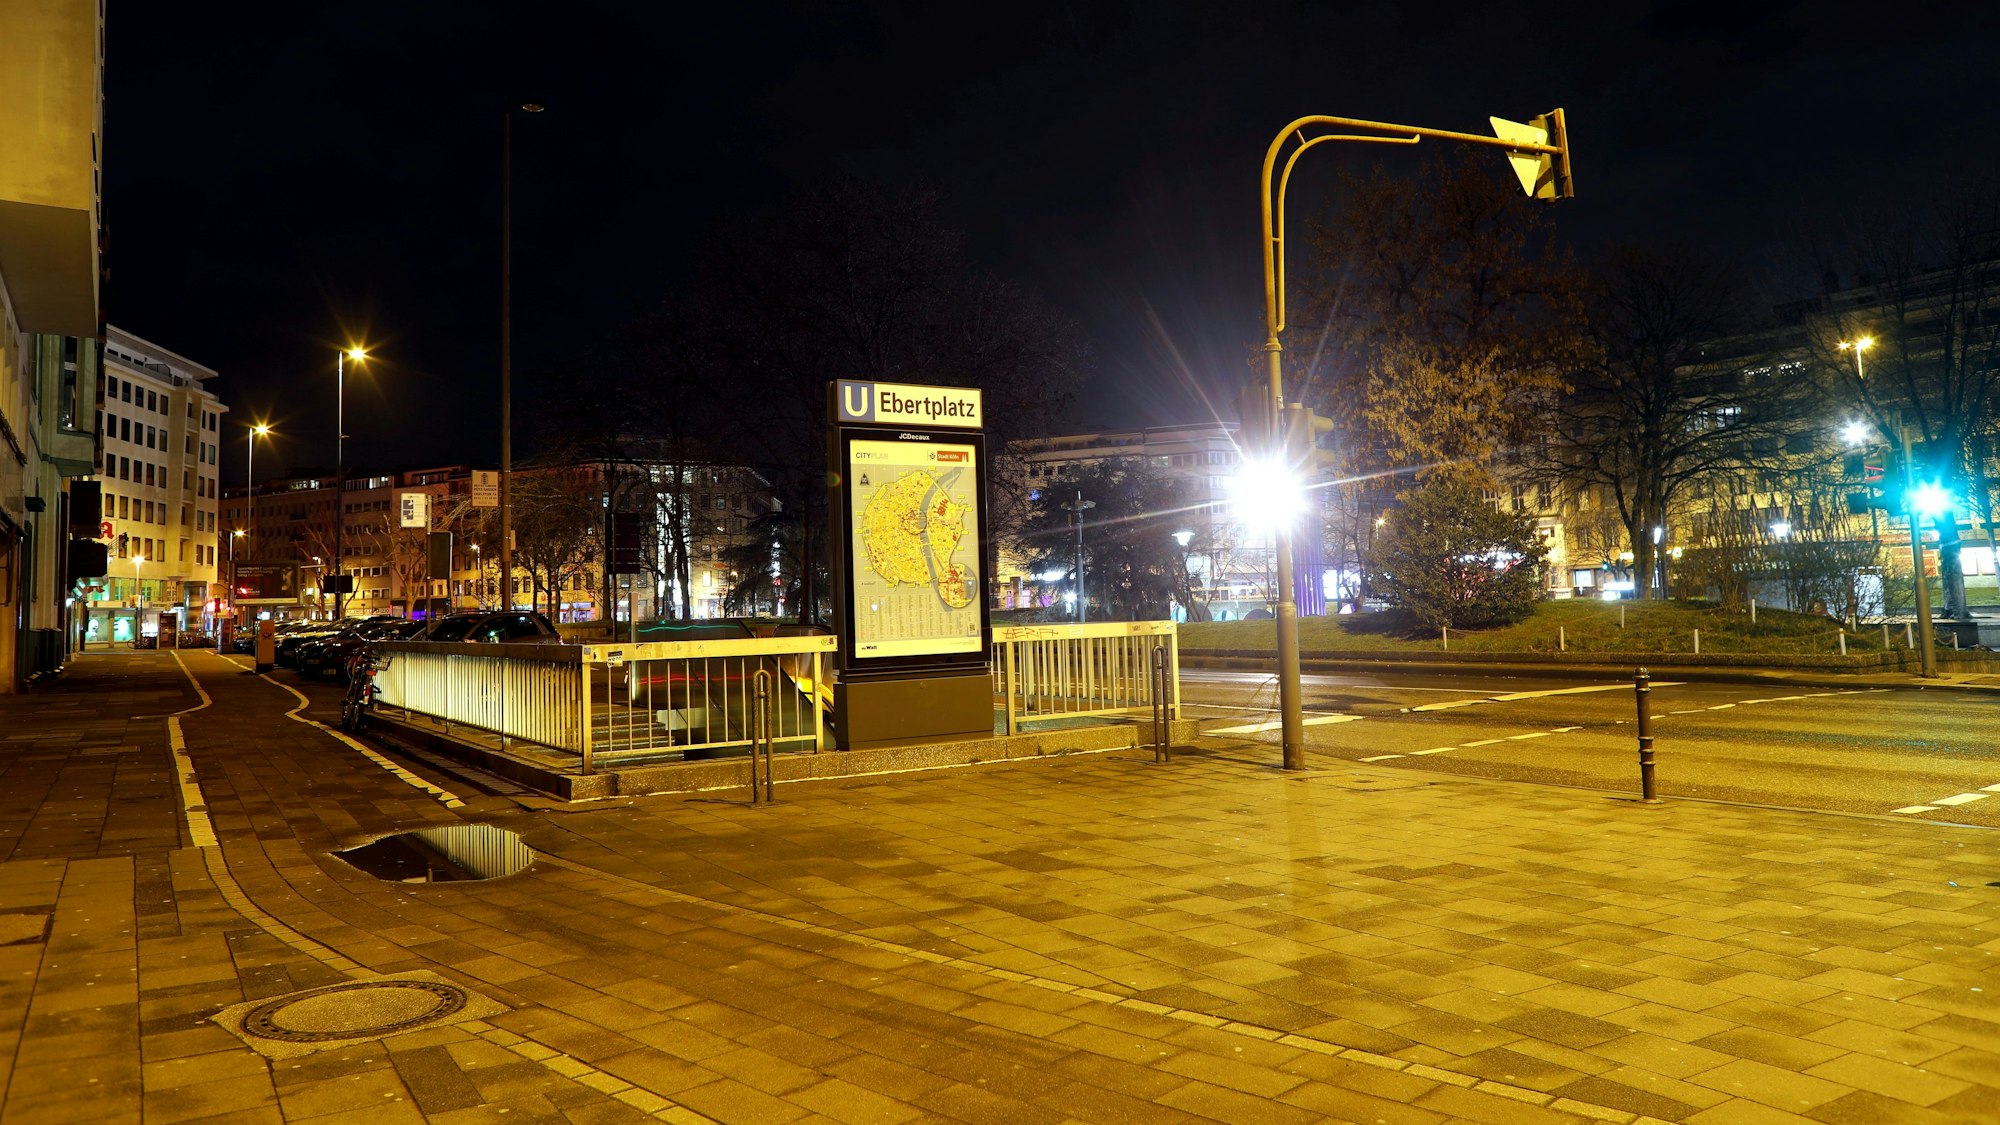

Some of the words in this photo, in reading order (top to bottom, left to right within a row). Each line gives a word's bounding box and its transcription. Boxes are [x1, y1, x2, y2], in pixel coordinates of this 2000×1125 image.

[845, 386, 868, 417] U
[880, 391, 975, 420] Ebertplatz
[898, 432, 930, 441] JCDecaux
